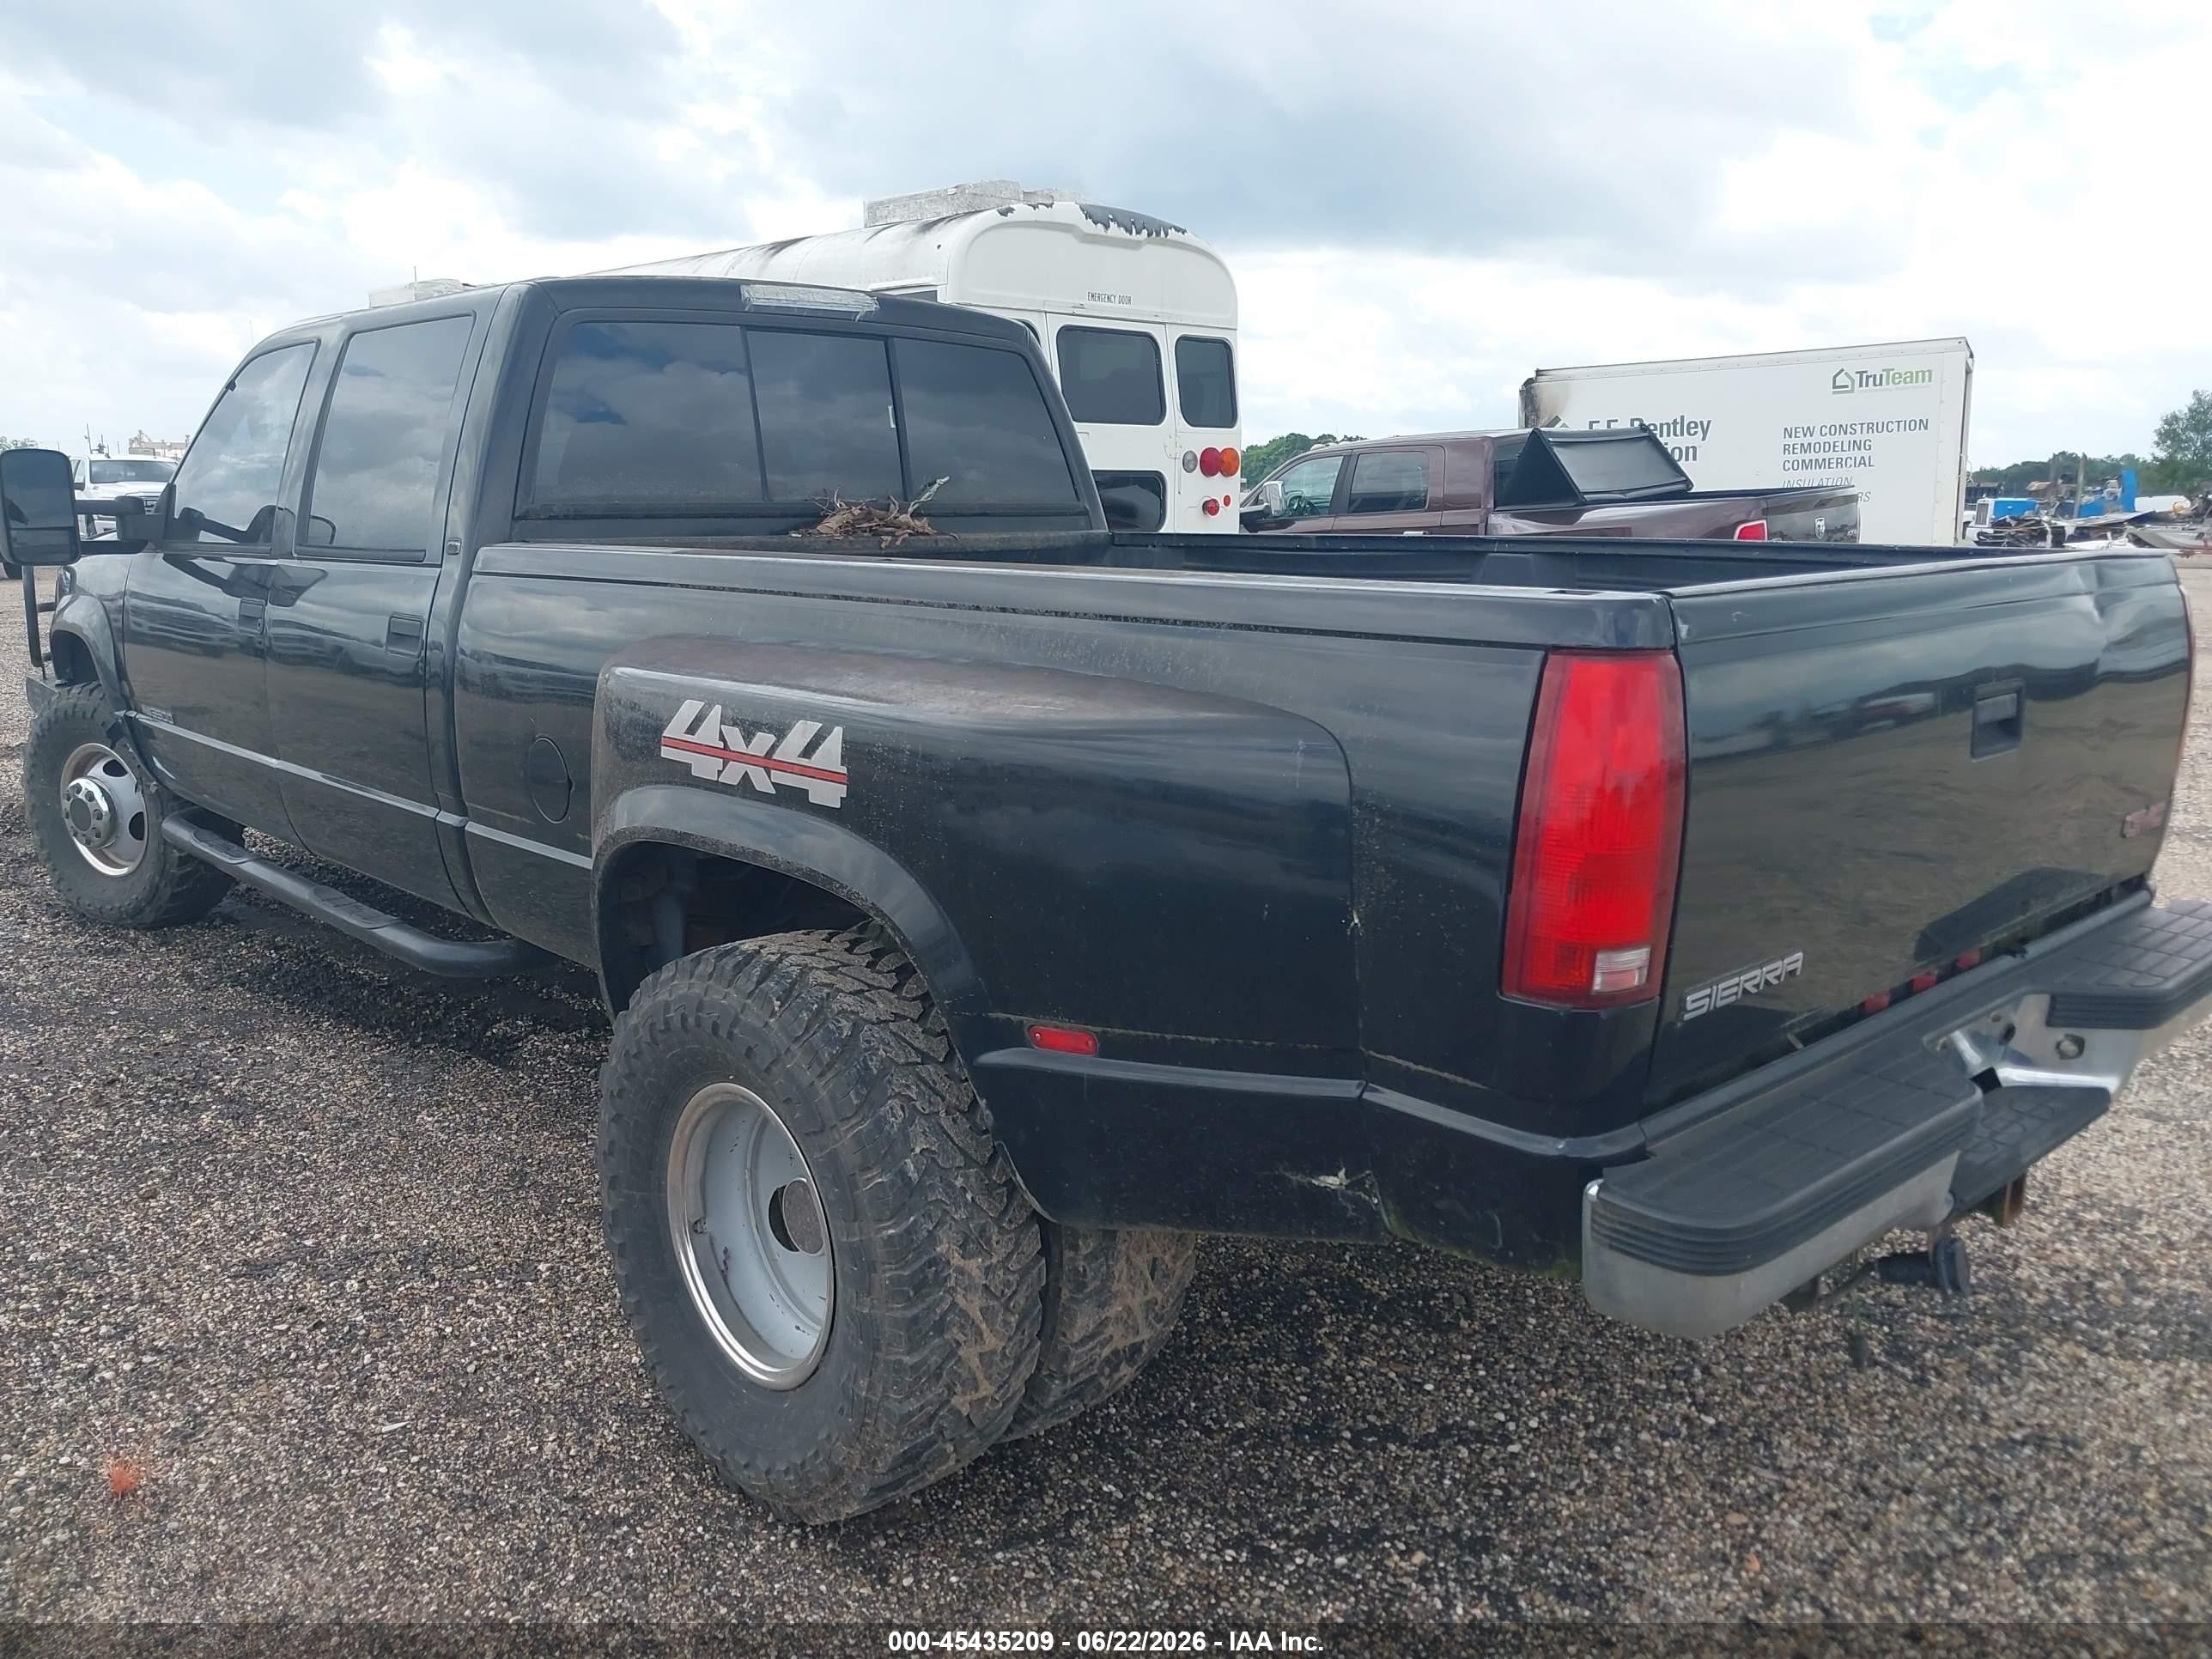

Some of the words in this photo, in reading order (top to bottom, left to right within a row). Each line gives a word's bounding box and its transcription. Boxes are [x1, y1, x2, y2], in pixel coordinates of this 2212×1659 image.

[1087, 291, 1116, 304] EMERGENCY
[1118, 295, 1132, 305] DOOR
[1855, 368, 1932, 388] TruTeam
[1783, 426, 1815, 440] NEW
[1820, 418, 1929, 437] CONSTRUCTION
[1783, 439, 1873, 455] REMODELING
[1783, 455, 1875, 471] COMMERCIAL
[1782, 476, 1853, 489] INSULATION
[660, 699, 848, 809] 4x4
[1683, 951, 1804, 1021] SIERRA
